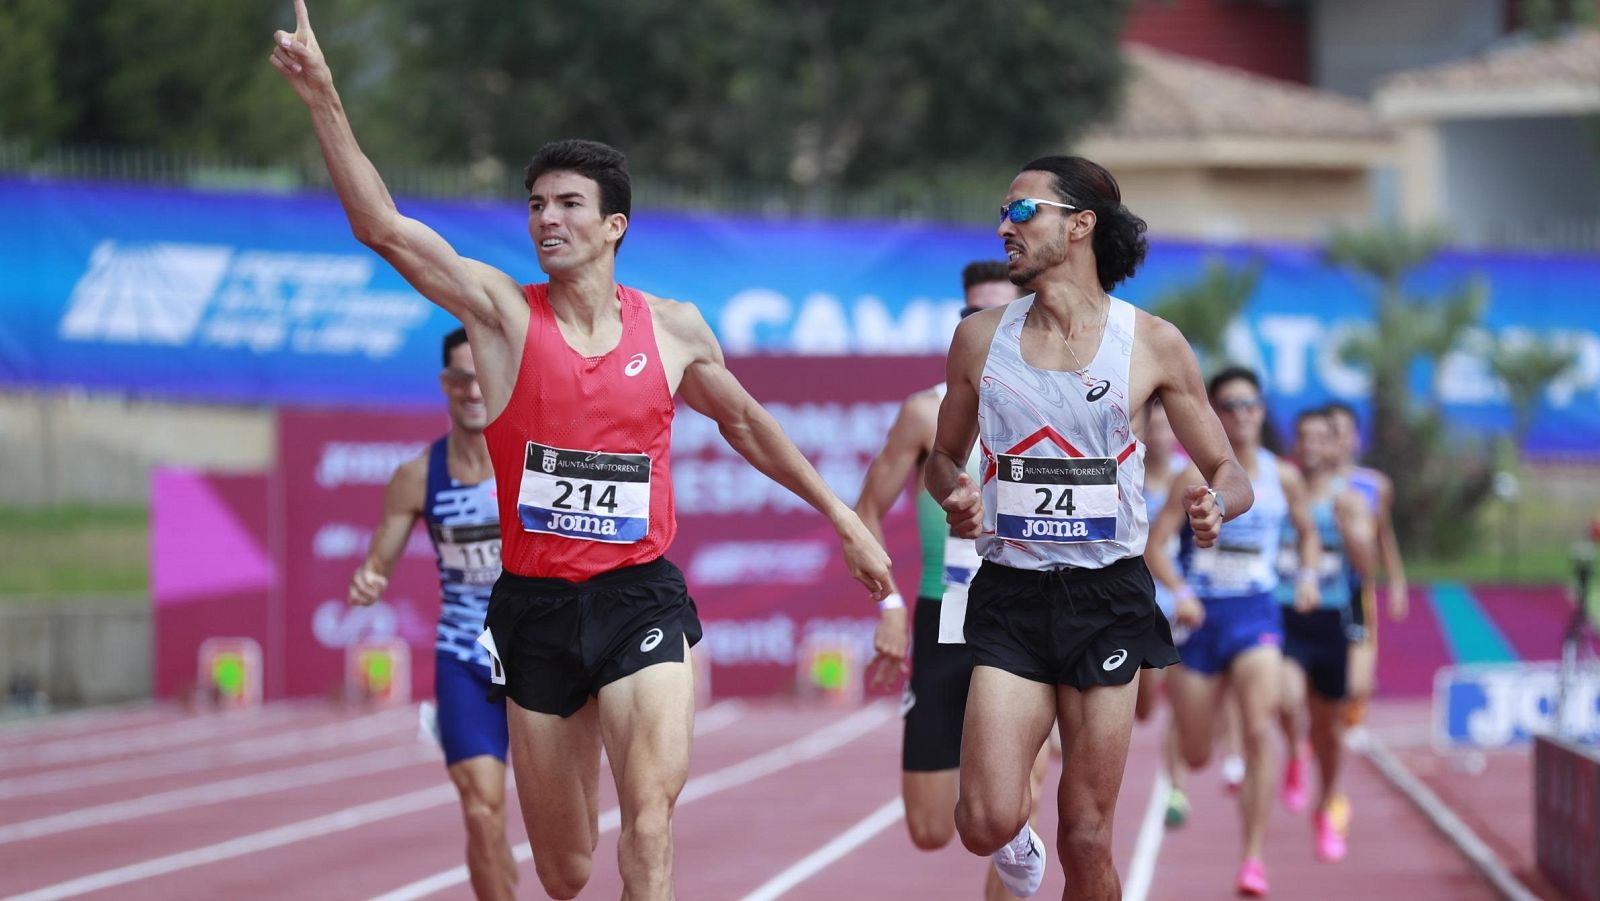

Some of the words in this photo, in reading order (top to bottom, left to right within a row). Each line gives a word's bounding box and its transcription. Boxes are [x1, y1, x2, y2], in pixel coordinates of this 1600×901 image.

[607, 463, 640, 473] TORRENT
[1024, 466, 1069, 475] AJUNTAMENT
[1071, 466, 1106, 476] TORRENT
[552, 480, 618, 514] 214
[1034, 487, 1076, 516] 24
[547, 512, 617, 536] Joma
[1022, 519, 1088, 537] Joma
